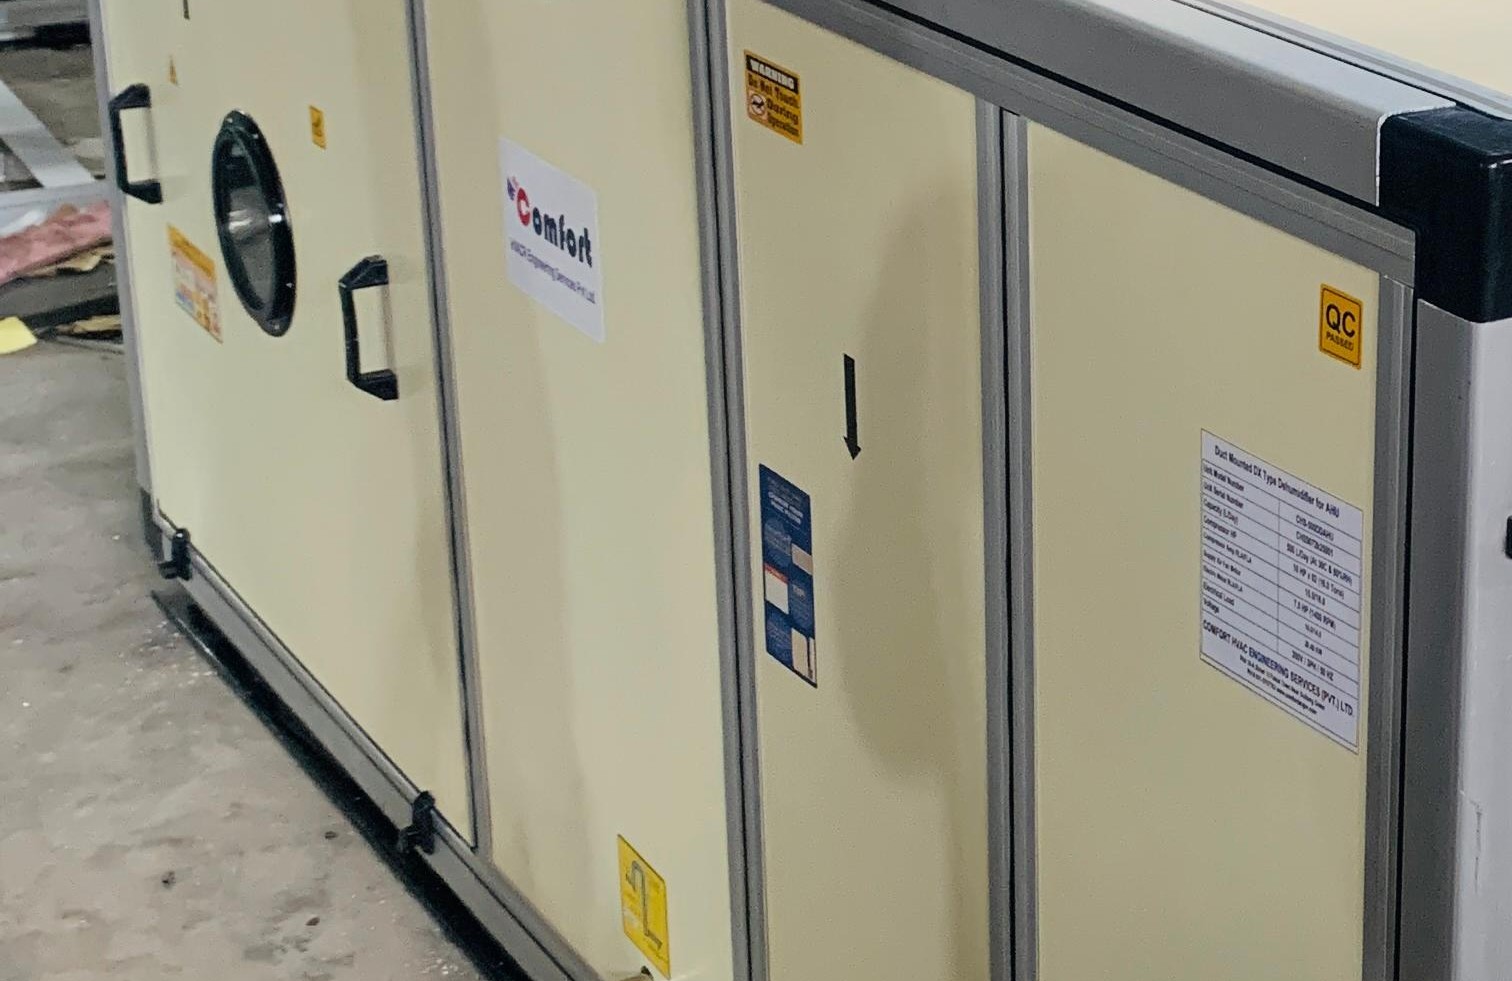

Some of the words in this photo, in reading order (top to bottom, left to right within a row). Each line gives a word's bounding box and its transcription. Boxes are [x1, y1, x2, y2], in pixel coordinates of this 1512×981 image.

[750, 59, 794, 89] WARNING
[517, 188, 592, 268] Comfort
[1326, 303, 1356, 338] QC
[1215, 445, 1227, 460] Duct
[1229, 453, 1252, 473] Mounted
[1254, 465, 1261, 478] DX
[1263, 470, 1276, 486] Type
[1278, 478, 1314, 504] Dehumidifier
[1316, 497, 1324, 509] for
[1227, 477, 1244, 491] Number
[1203, 620, 1231, 642] COMFORT
[1232, 637, 1248, 654] HVAC
[1249, 647, 1289, 678] ENGINEERING
[1290, 671, 1320, 697] SERVICES
